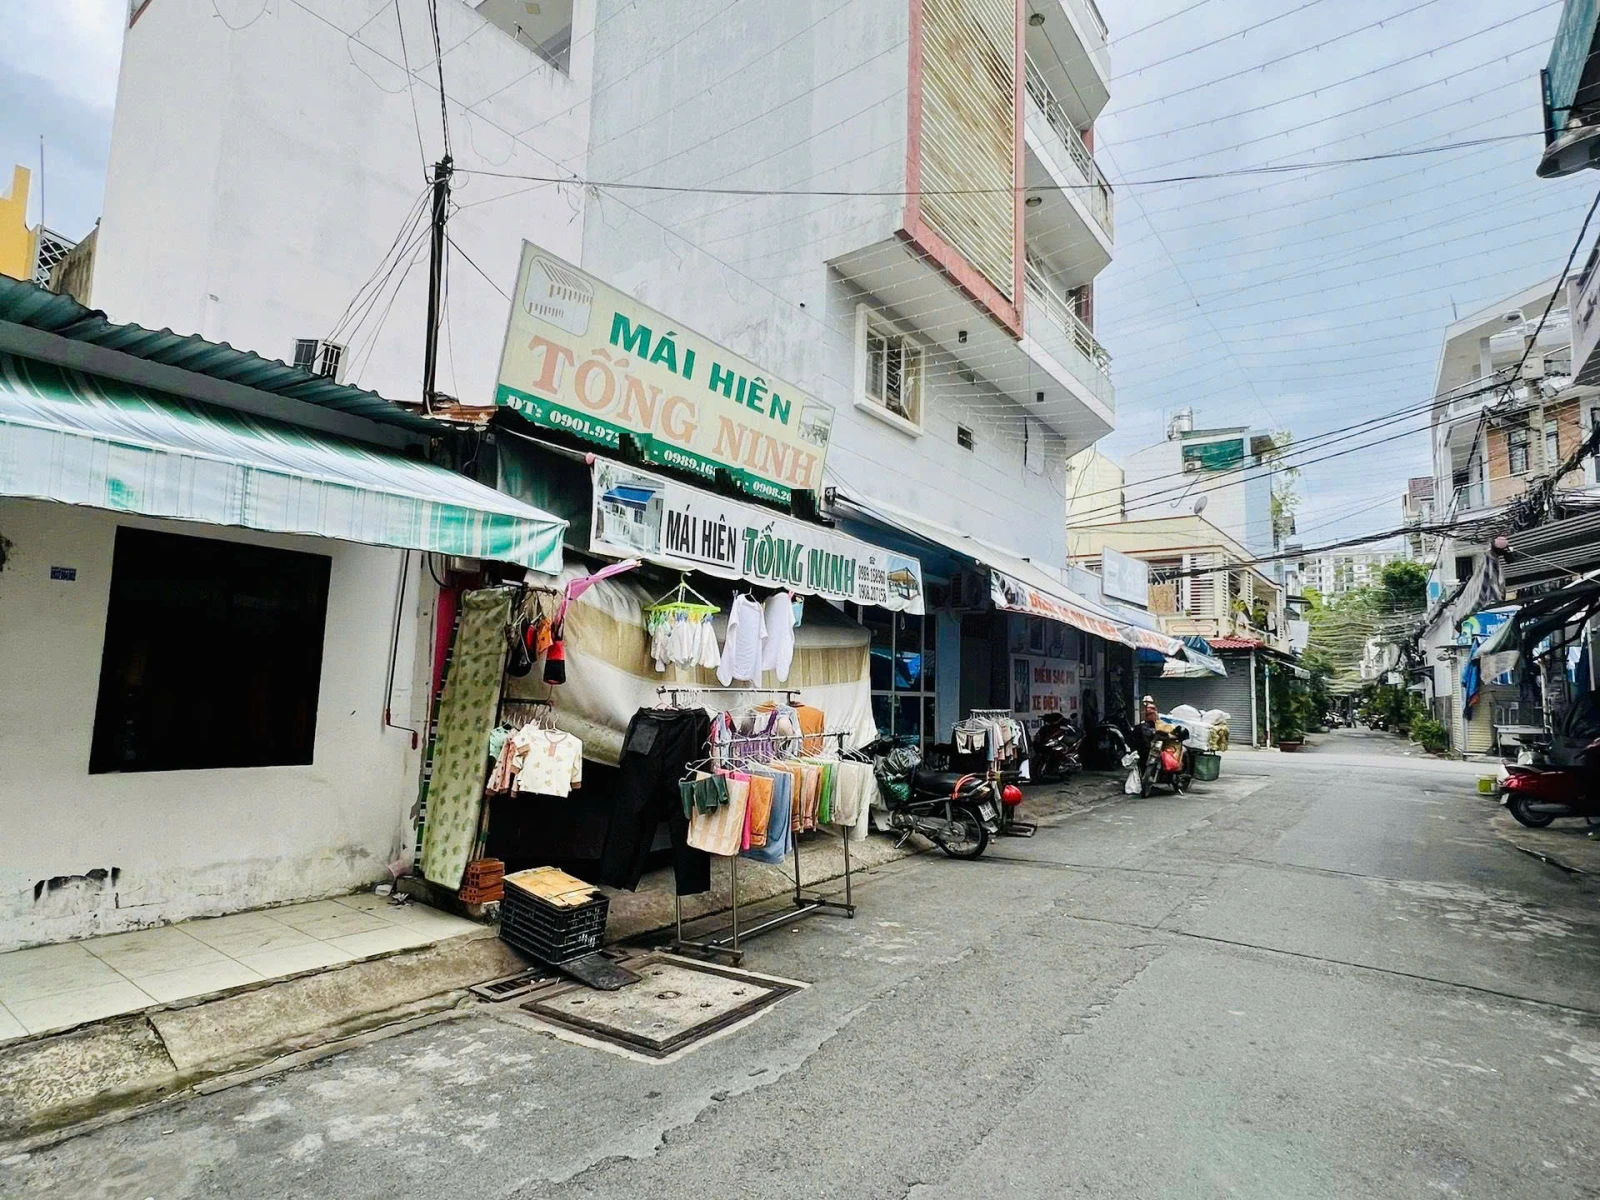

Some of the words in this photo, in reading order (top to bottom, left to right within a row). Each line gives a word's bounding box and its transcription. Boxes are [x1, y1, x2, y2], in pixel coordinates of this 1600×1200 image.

[528, 335, 699, 445] TỐNG
[712, 415, 818, 488] NINH
[609, 312, 696, 381] MÁI
[708, 362, 792, 425] HIÊN
[550, 410, 620, 445] 0901.972
[665, 504, 697, 554] MÁI
[702, 513, 737, 563] HIÊN
[742, 521, 804, 586] TỐNG
[807, 548, 856, 597] NINH
